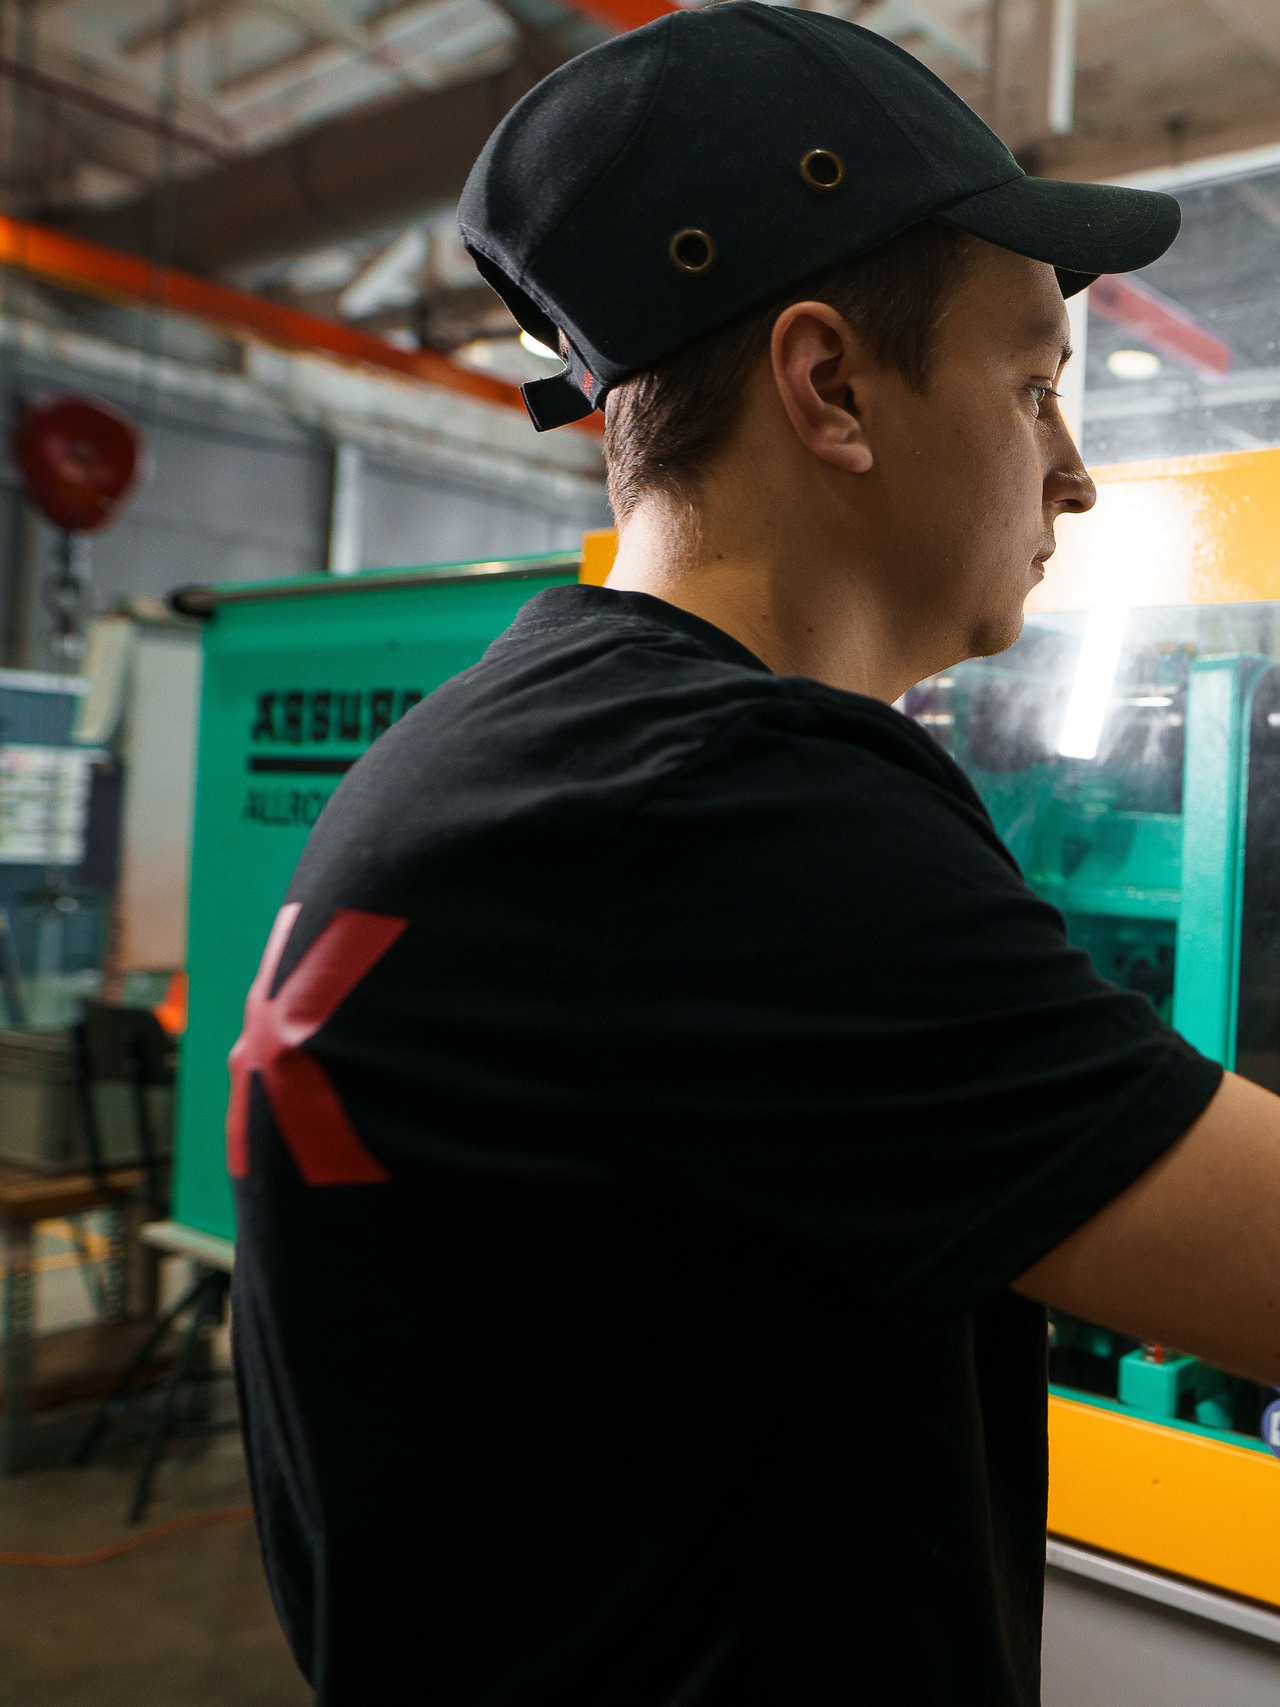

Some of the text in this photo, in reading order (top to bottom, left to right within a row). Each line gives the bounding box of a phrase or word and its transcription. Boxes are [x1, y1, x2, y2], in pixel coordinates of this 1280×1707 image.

[252, 689, 422, 743] ARBUR
[242, 789, 330, 827] ALLRO
[225, 902, 412, 1188] K
